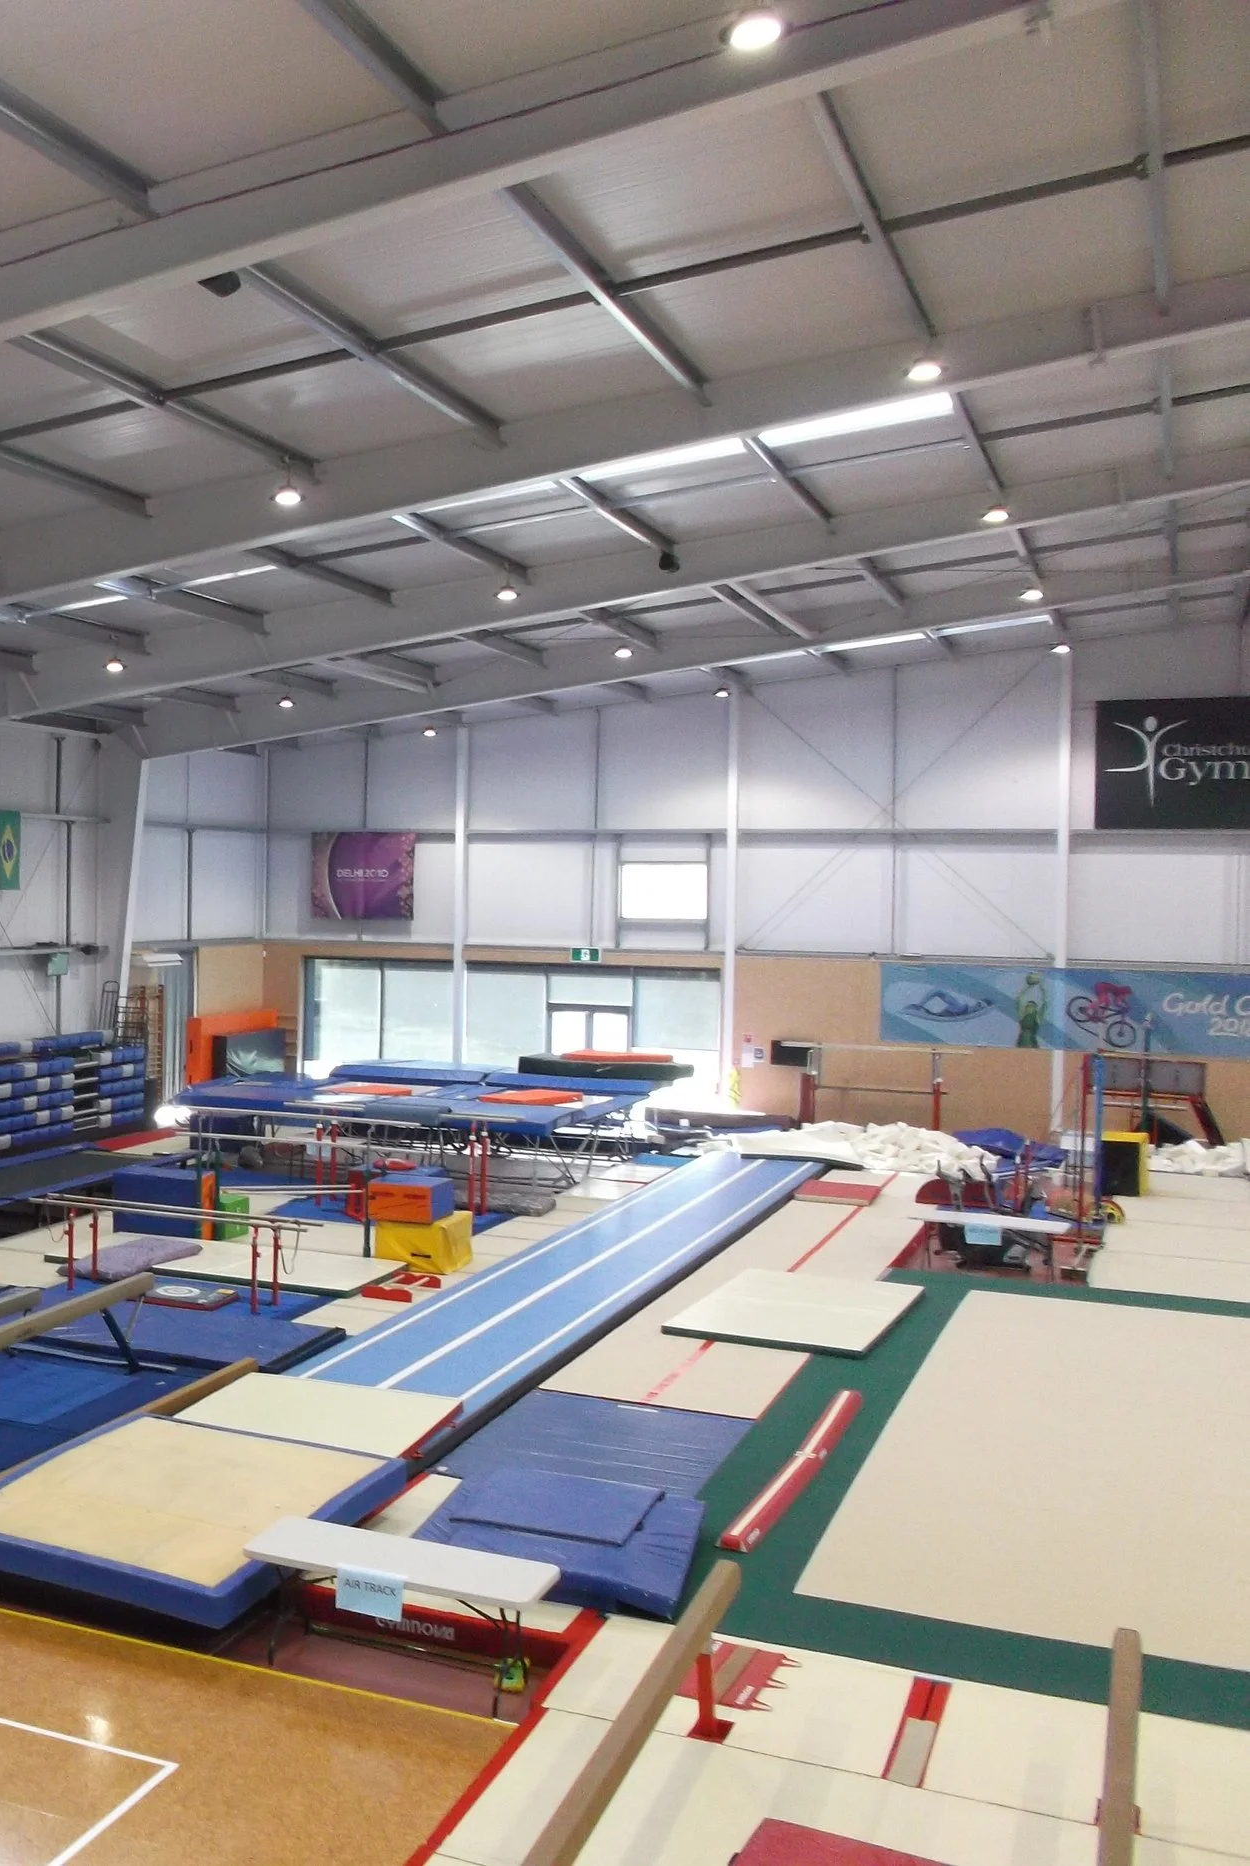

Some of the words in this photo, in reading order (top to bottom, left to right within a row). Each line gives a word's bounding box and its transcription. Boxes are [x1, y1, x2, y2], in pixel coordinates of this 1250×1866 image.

[336, 869, 363, 877] DELHI
[365, 869, 389, 877] 2010
[1162, 992, 1230, 1016] Gold
[344, 1578, 360, 1589] AIR
[364, 1581, 396, 1597] TRACK
